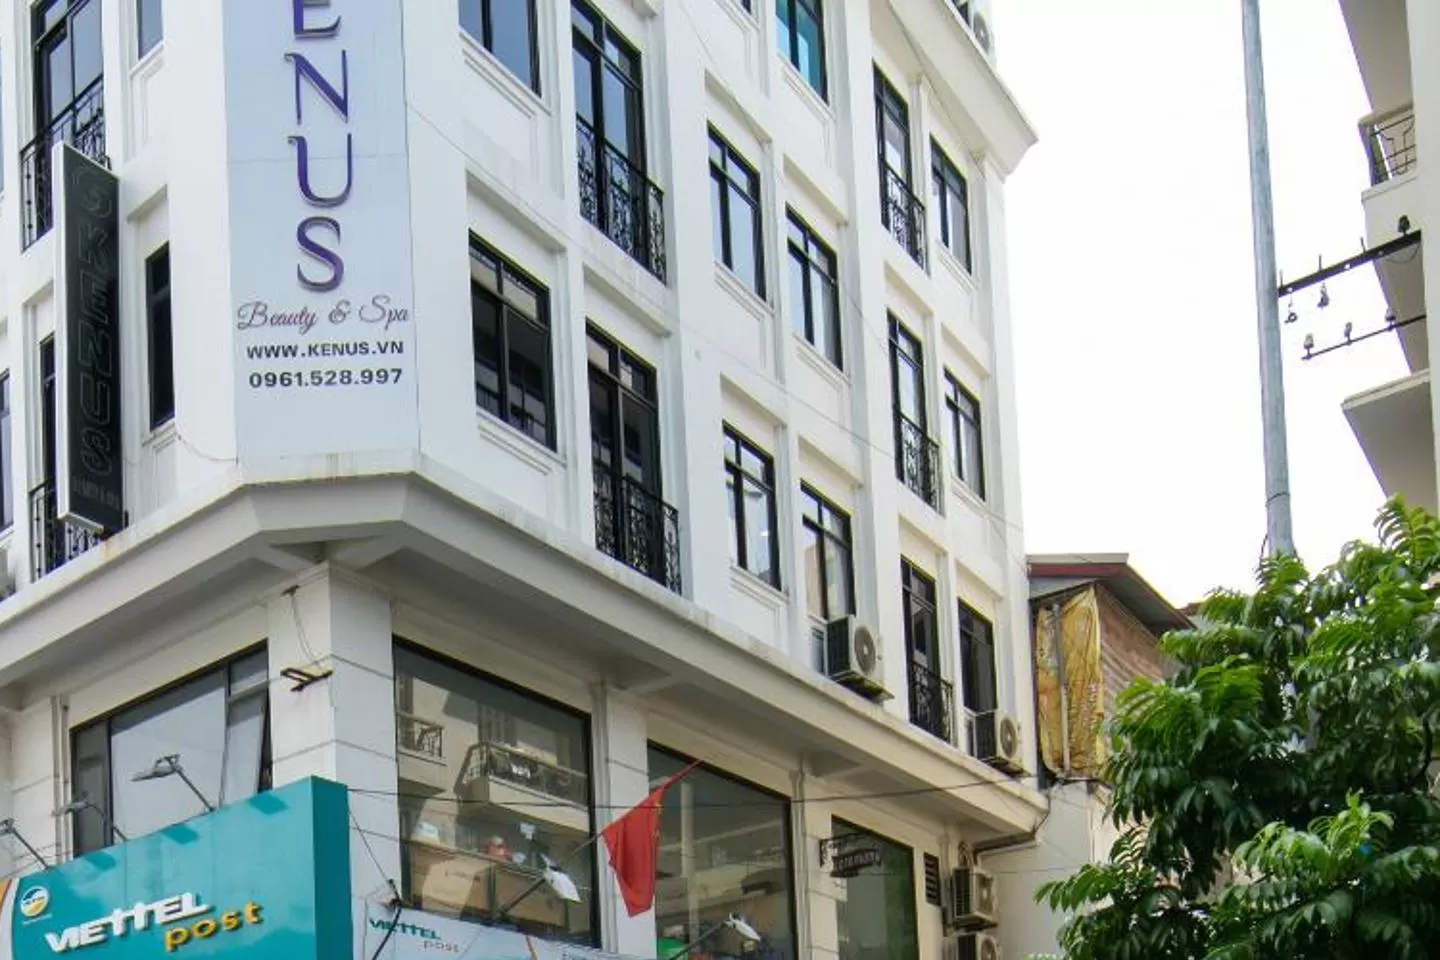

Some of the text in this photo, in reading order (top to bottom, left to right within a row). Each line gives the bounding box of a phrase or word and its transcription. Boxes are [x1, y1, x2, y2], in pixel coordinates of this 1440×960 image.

[237, 295, 409, 335] Beauty & Spa
[246, 340, 404, 360] WWW.KENUS.VN
[248, 368, 402, 388] 0961.528.997
[44, 891, 213, 953] VIETTEL
[164, 900, 264, 952] post
[369, 917, 441, 940] VIETTEL
